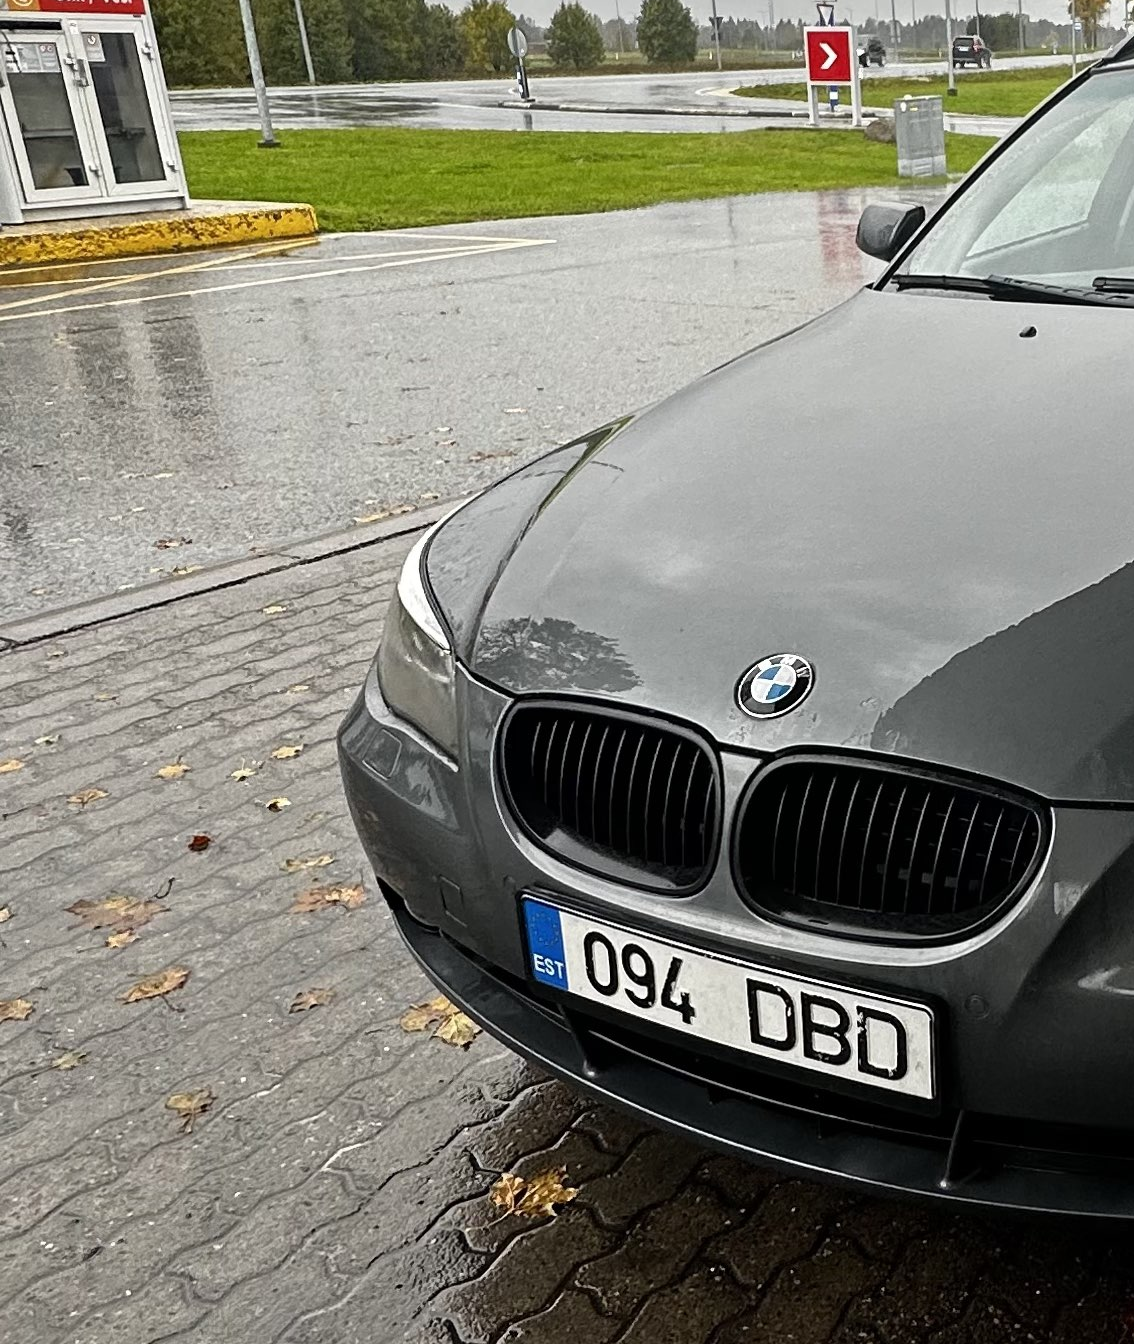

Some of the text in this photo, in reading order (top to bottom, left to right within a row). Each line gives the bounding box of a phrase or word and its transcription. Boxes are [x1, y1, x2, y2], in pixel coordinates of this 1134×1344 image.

[533, 953, 565, 980] EST
[583, 931, 907, 1081] 094 DBD
